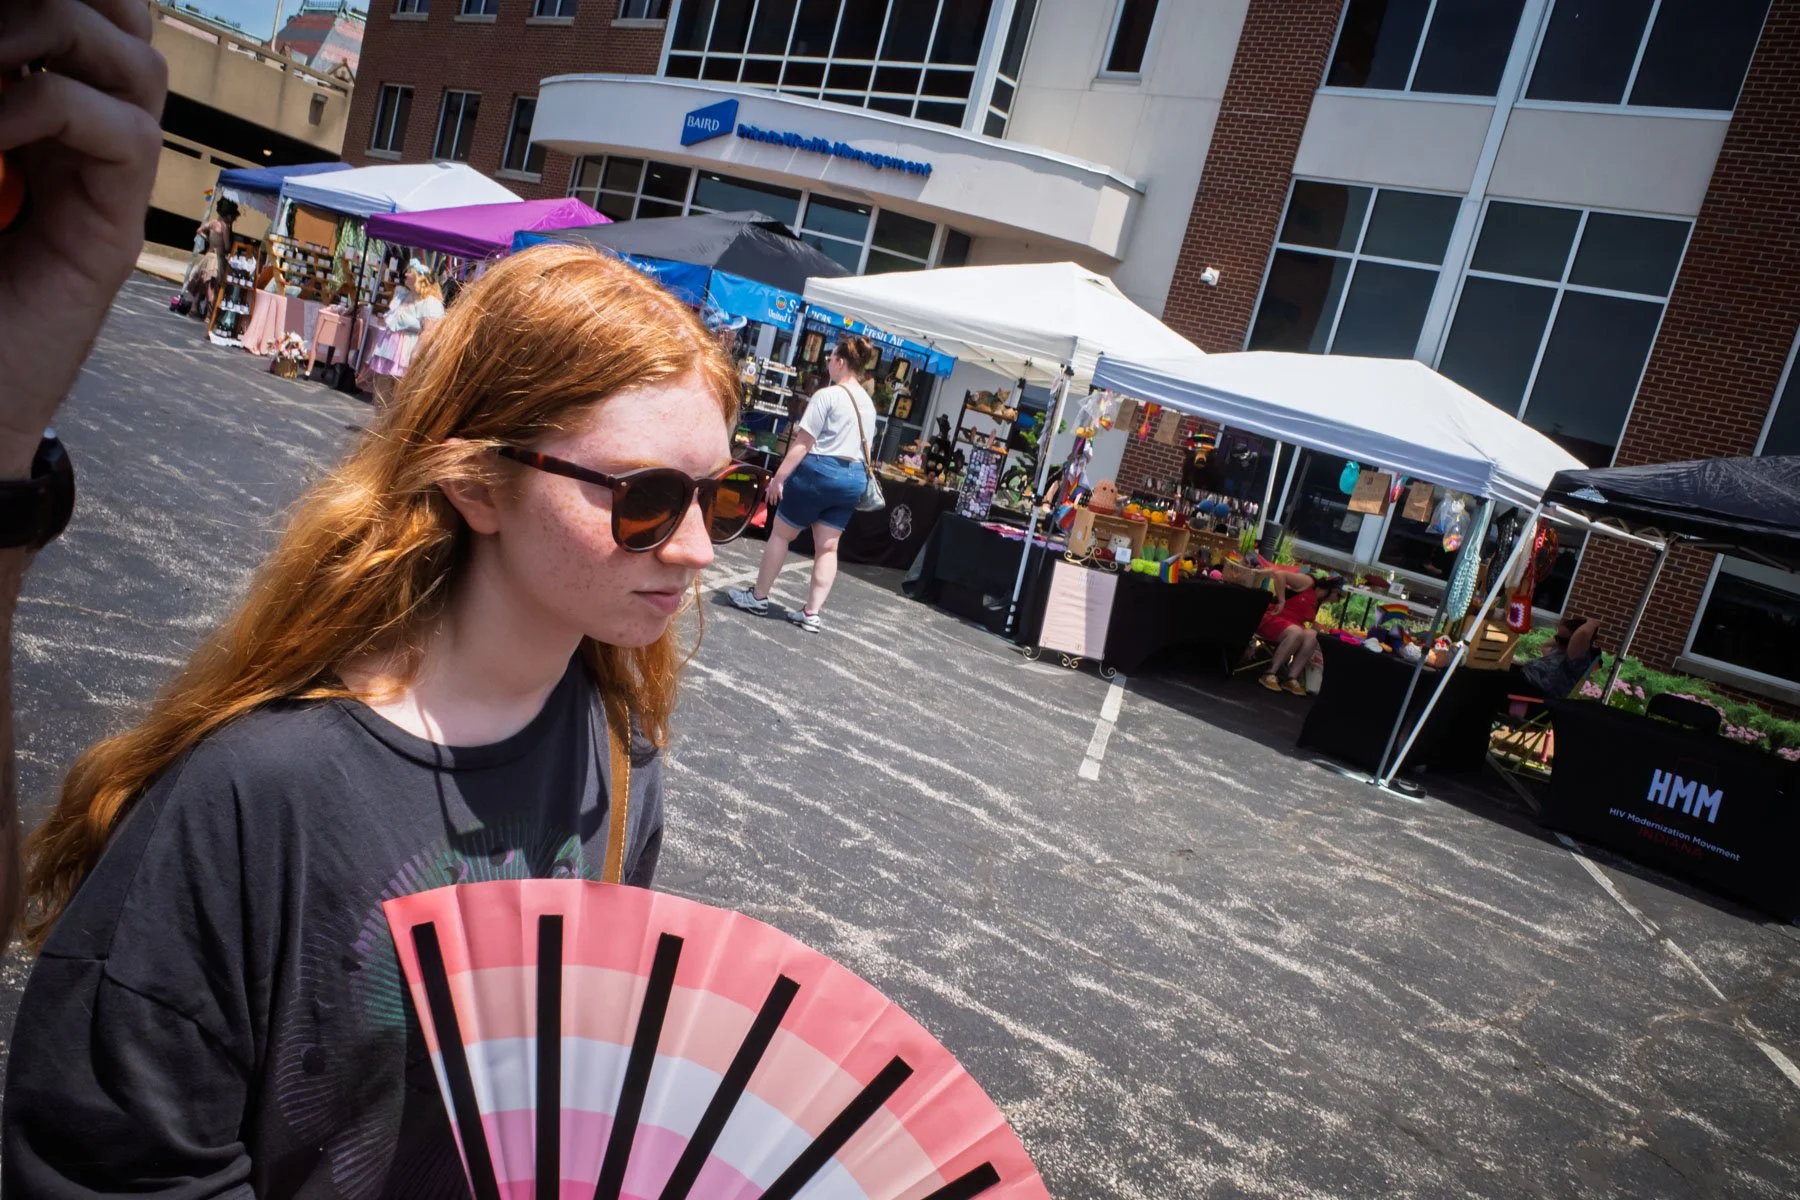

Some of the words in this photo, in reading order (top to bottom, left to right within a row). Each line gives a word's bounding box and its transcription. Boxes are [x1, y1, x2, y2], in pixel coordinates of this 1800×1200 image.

[686, 115, 720, 132] BAIRD
[782, 131, 834, 155] Wealth
[833, 141, 933, 177] Management
[768, 308, 788, 323] United
[1646, 767, 1725, 824] HMM
[1608, 807, 1627, 819] HIV
[1627, 812, 1691, 841] Modernization
[1692, 835, 1741, 862] Movement
